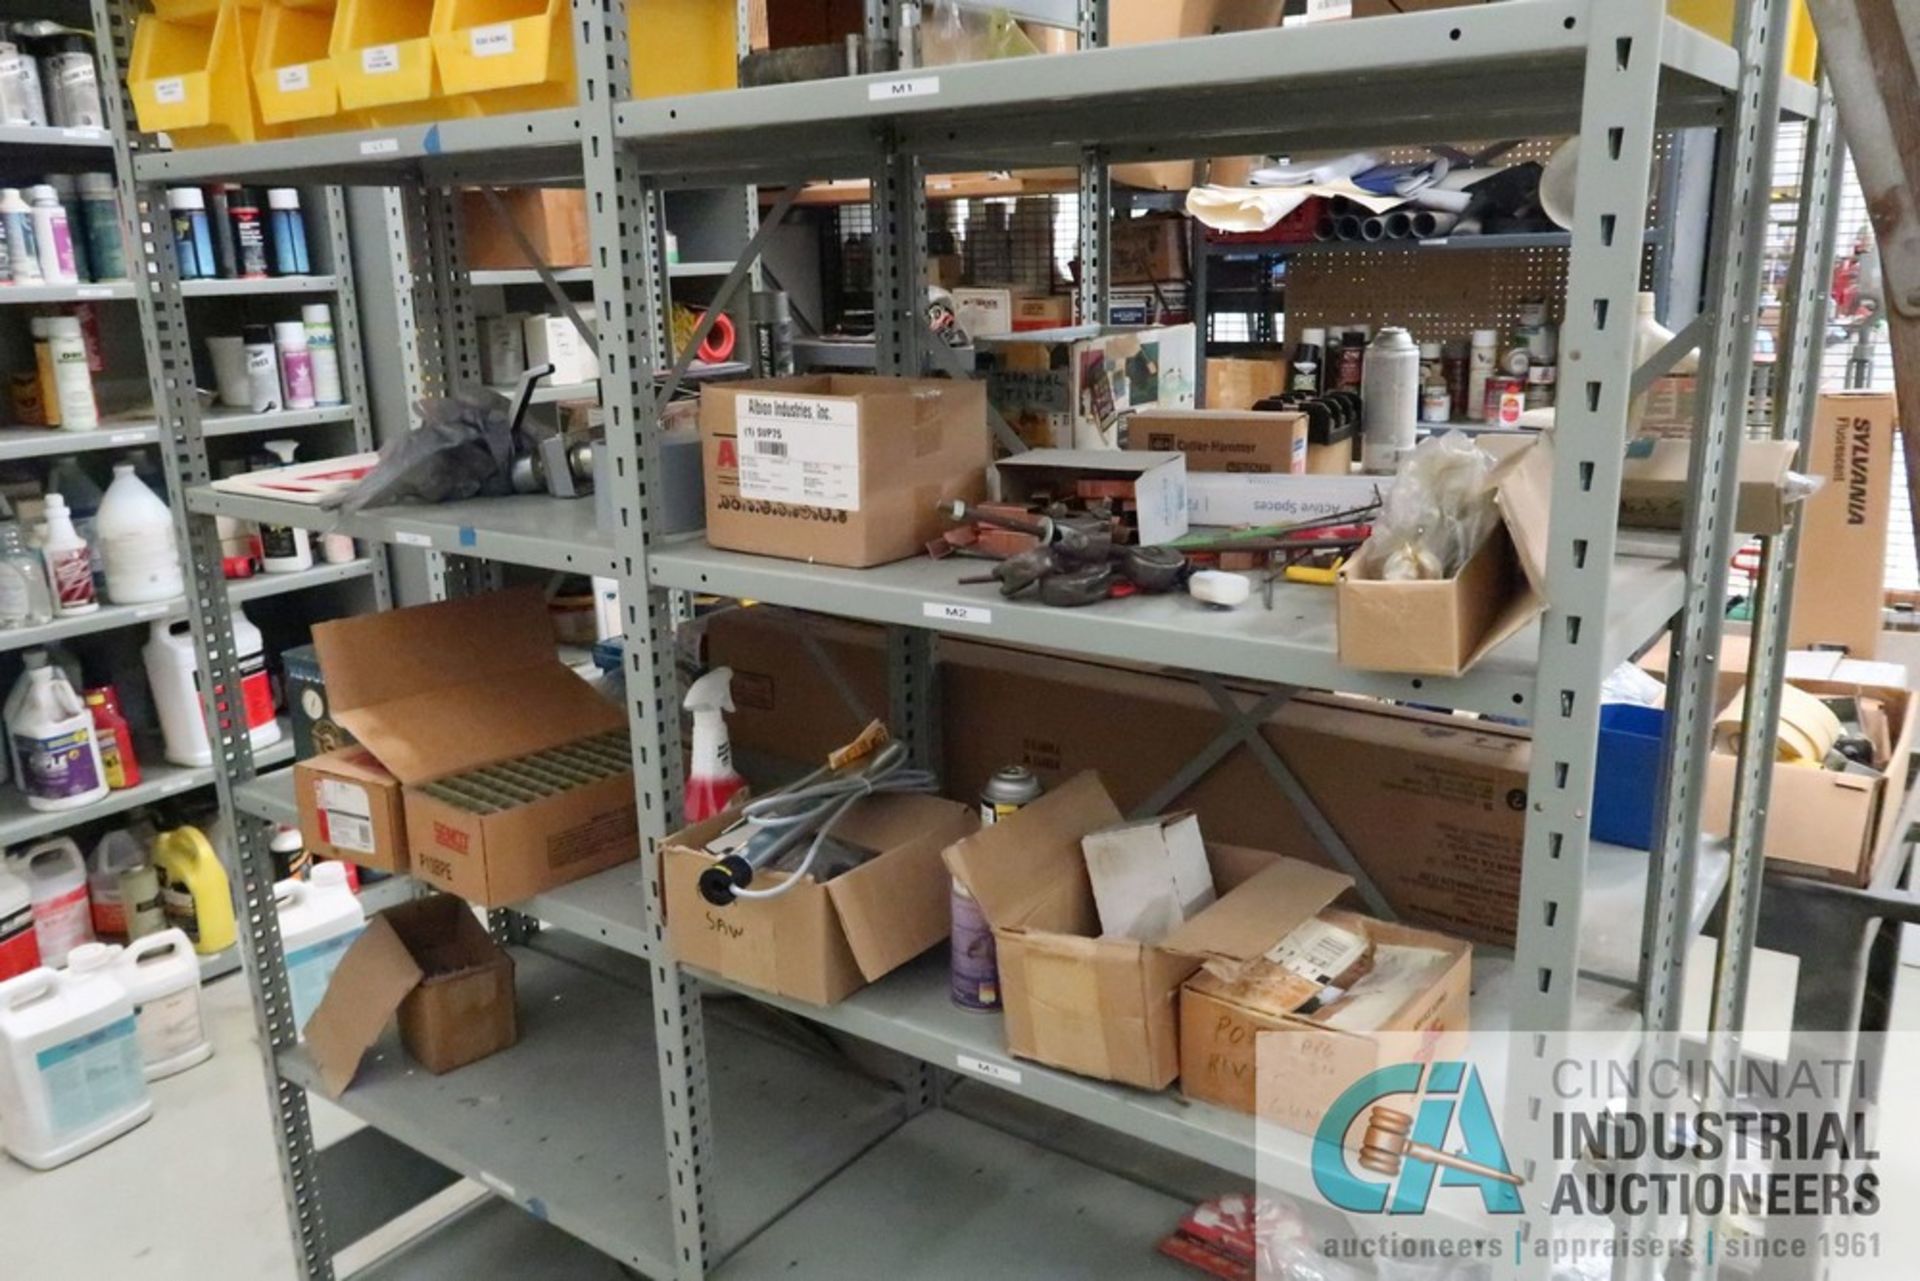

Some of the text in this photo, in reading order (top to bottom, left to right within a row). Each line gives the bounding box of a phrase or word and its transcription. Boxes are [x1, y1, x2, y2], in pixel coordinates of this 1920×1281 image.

[891, 82, 913, 95] M1
[748, 398, 773, 416] Albion
[816, 404, 832, 421] Inc.
[1833, 416, 1850, 482] Fluorescent
[1847, 416, 1871, 526] SYLVANIA
[945, 607, 968, 618] M2
[705, 912, 745, 939] SAW
